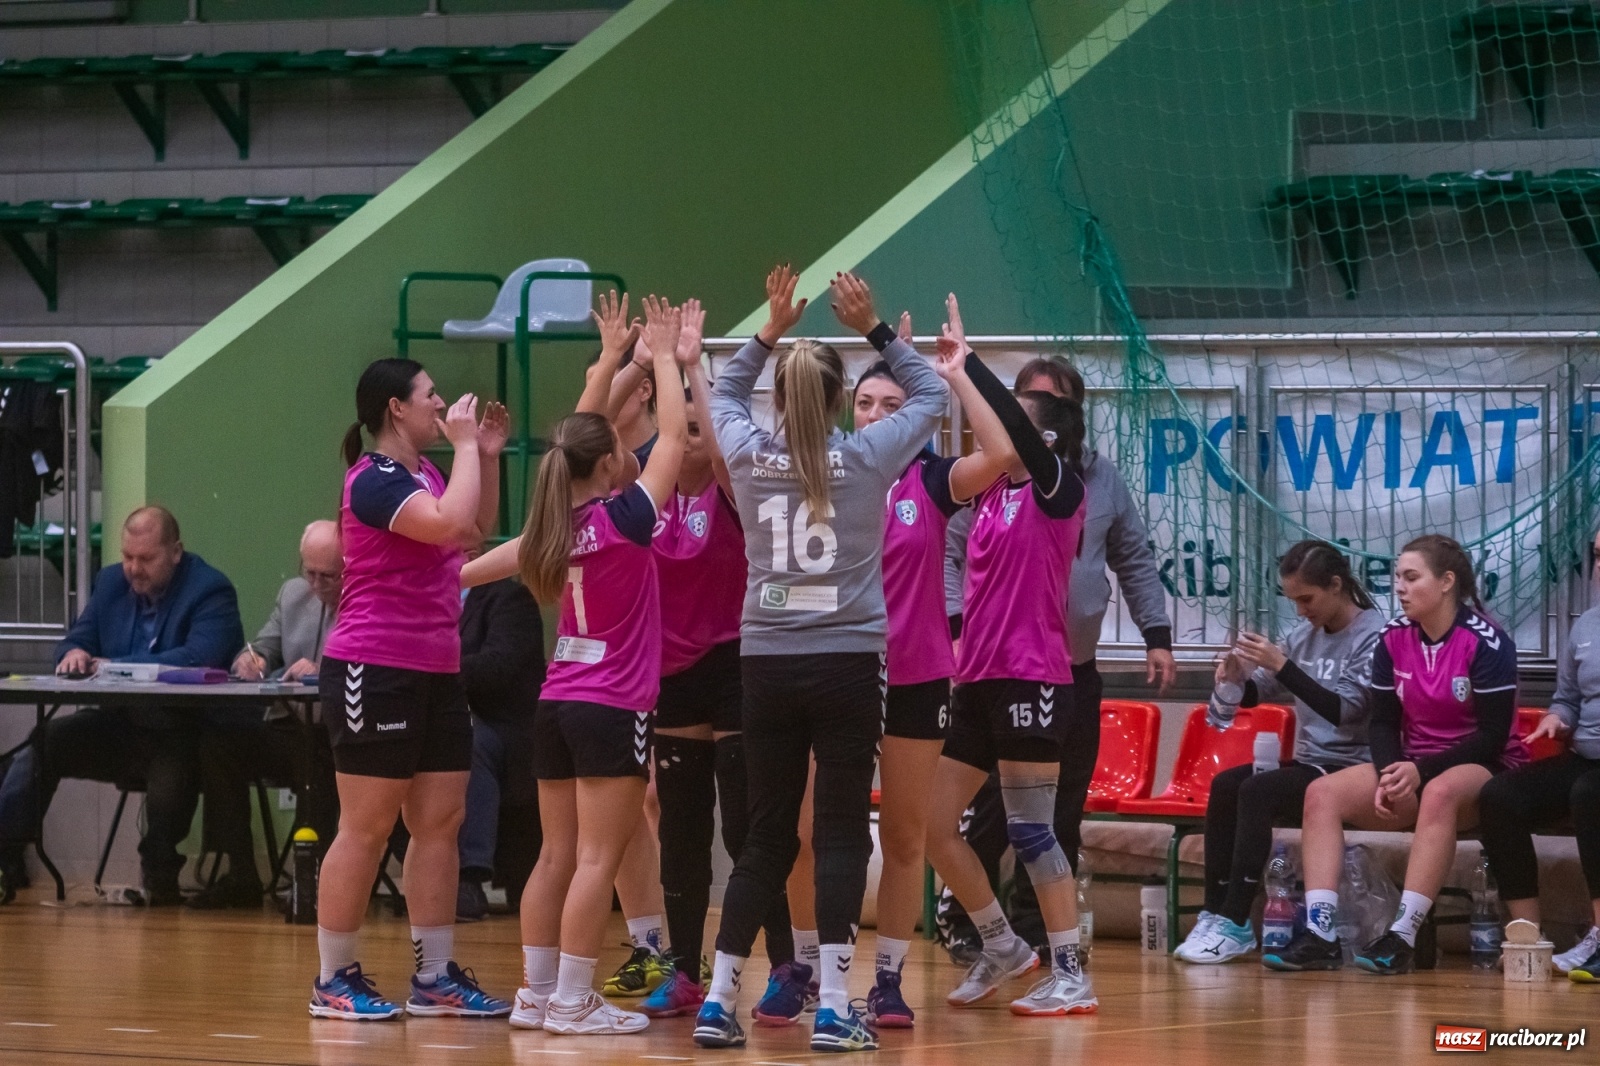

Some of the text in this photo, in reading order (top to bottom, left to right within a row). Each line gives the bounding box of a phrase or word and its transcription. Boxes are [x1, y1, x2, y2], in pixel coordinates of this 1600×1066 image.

[752, 451, 791, 471] LZS
[1149, 406, 1540, 495] POWIAT
[758, 495, 838, 574] 16
[1316, 657, 1335, 680] 12
[376, 720, 407, 732] hummel
[938, 704, 948, 729] 6
[1008, 703, 1033, 728] 15
[1147, 915, 1157, 951] SELECT
